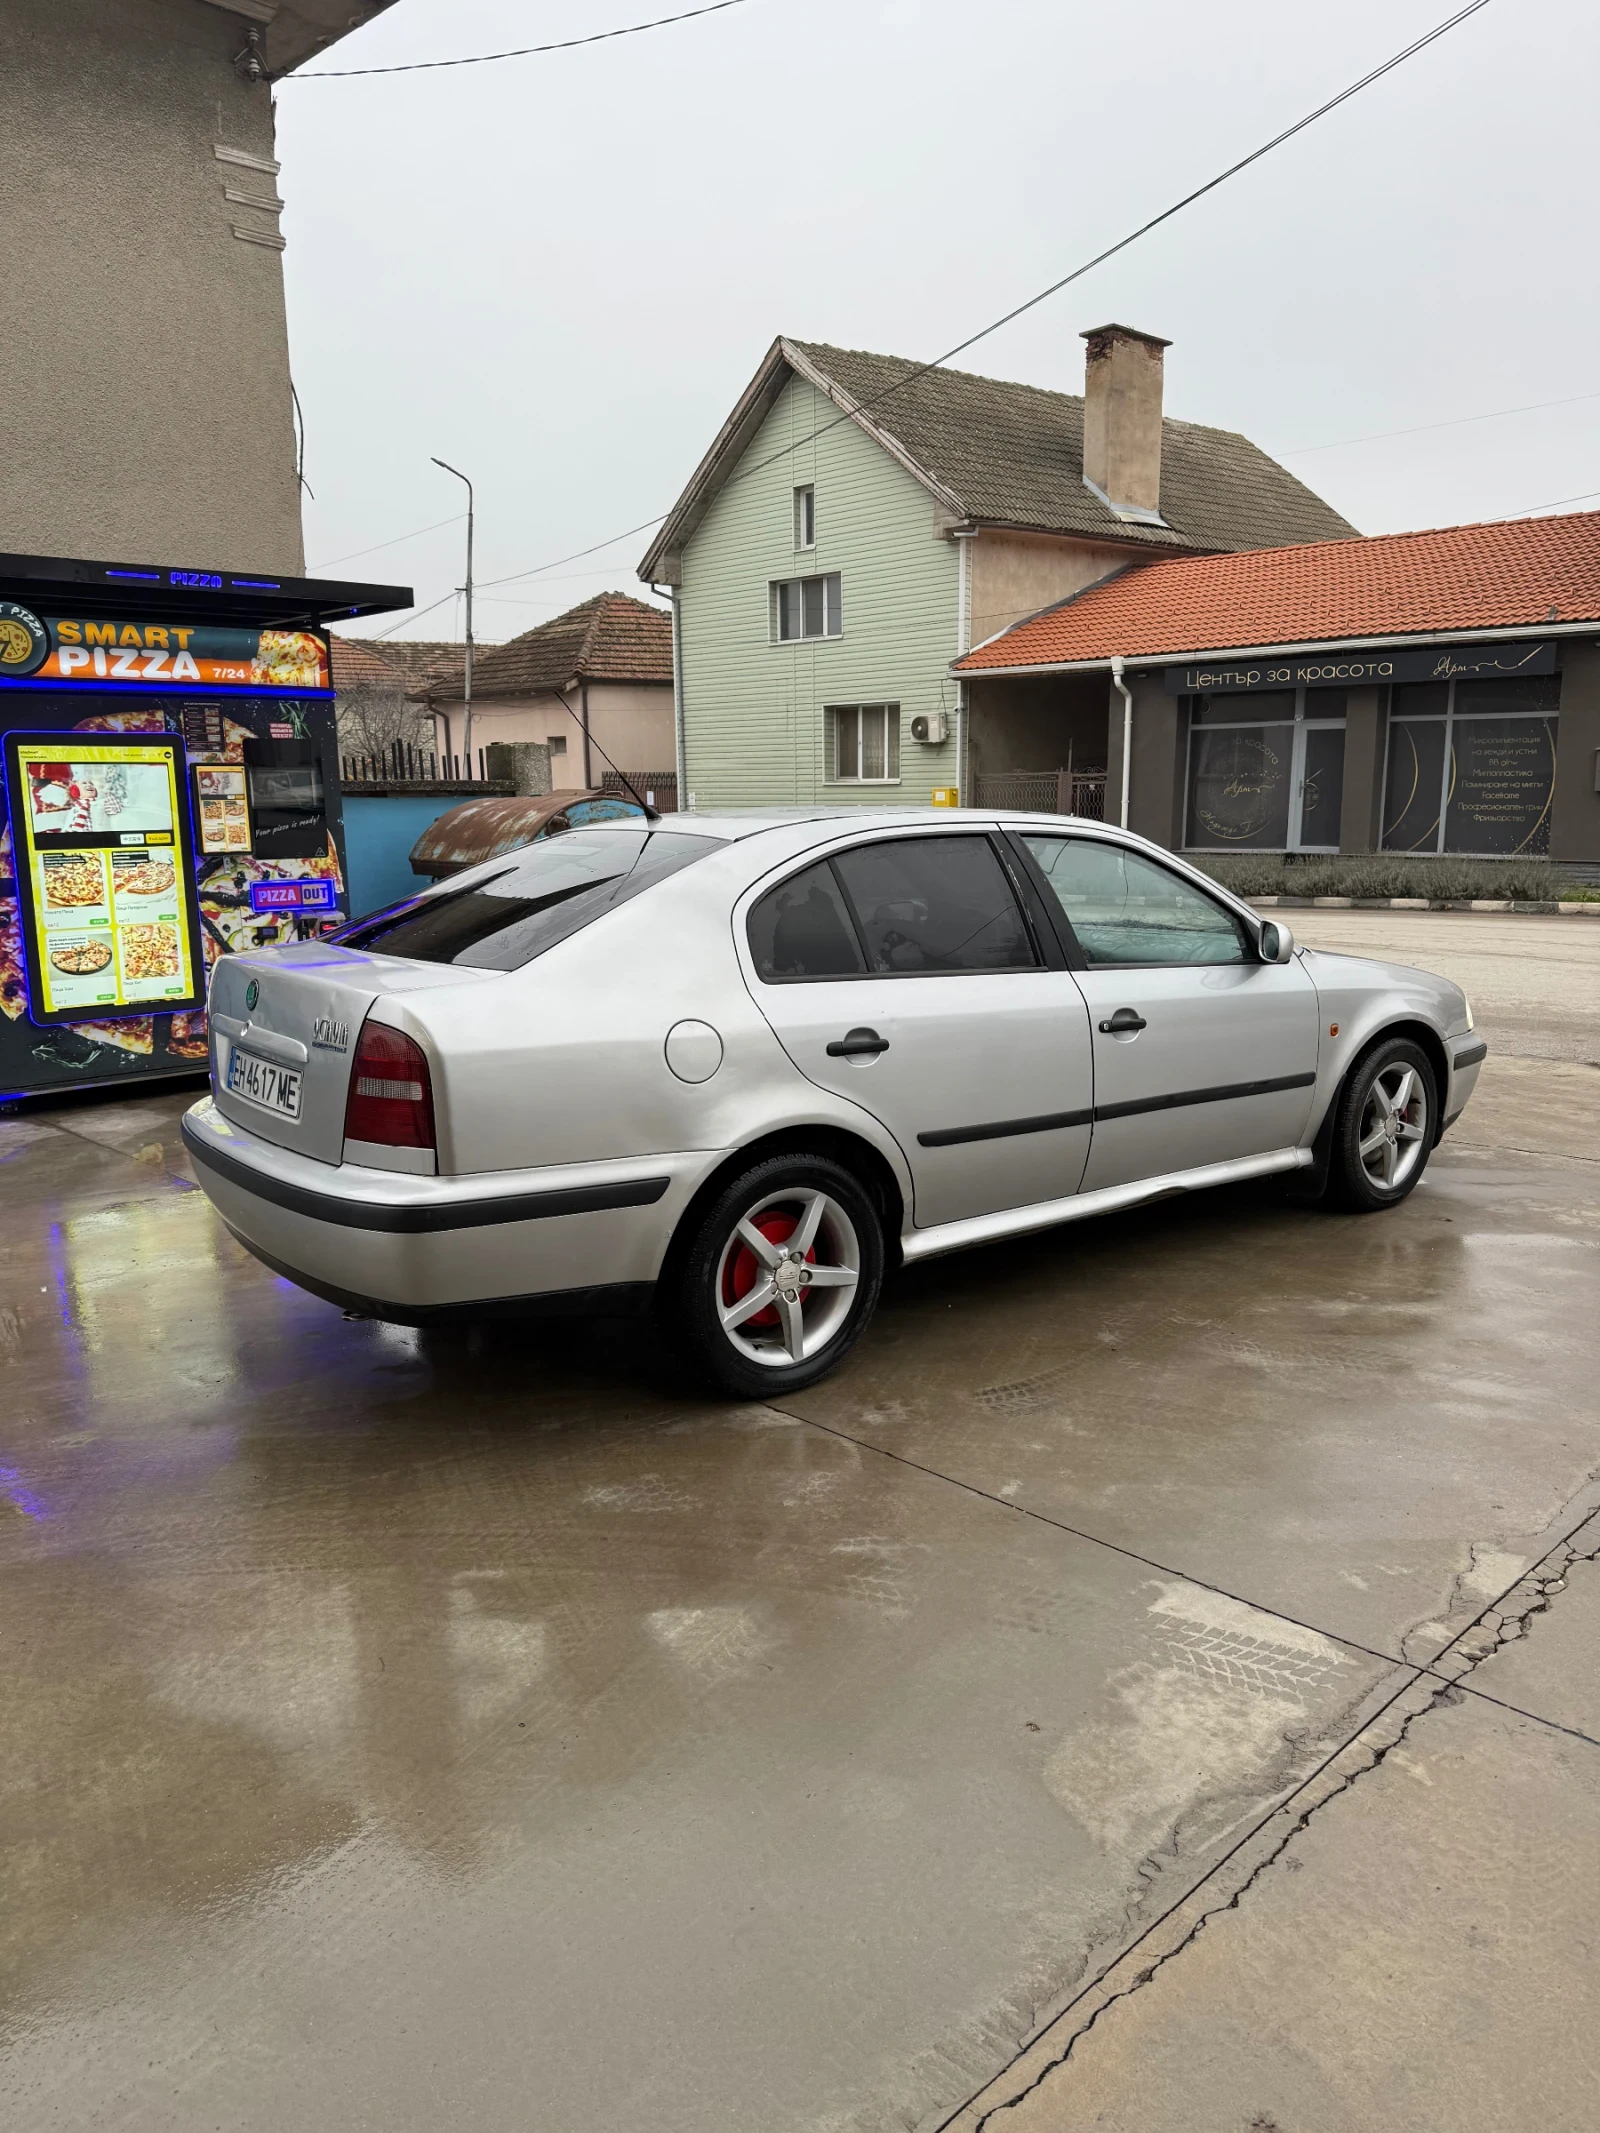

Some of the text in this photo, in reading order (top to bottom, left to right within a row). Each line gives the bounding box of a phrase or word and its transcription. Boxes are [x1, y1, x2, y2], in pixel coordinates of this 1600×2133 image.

[170, 571, 222, 588] PIZZA
[10, 606, 44, 637] PIZZA
[56, 620, 195, 650] SMART
[58, 645, 246, 680] PIZZA 7/24
[1186, 661, 1394, 690] Център за красота
[1515, 748, 1538, 756] устни
[1488, 758, 1500, 766] BB
[1472, 769, 1534, 777] Миглопластика
[1461, 780, 1544, 789] Ламиниране на мигли
[1481, 790, 1520, 799] Faceframe
[1457, 802, 1524, 811] Професионален
[1473, 813, 1526, 822] Фризьорство
[255, 814, 321, 839] Your pizza is ready!
[258, 888, 328, 903] PIZZA OUT
